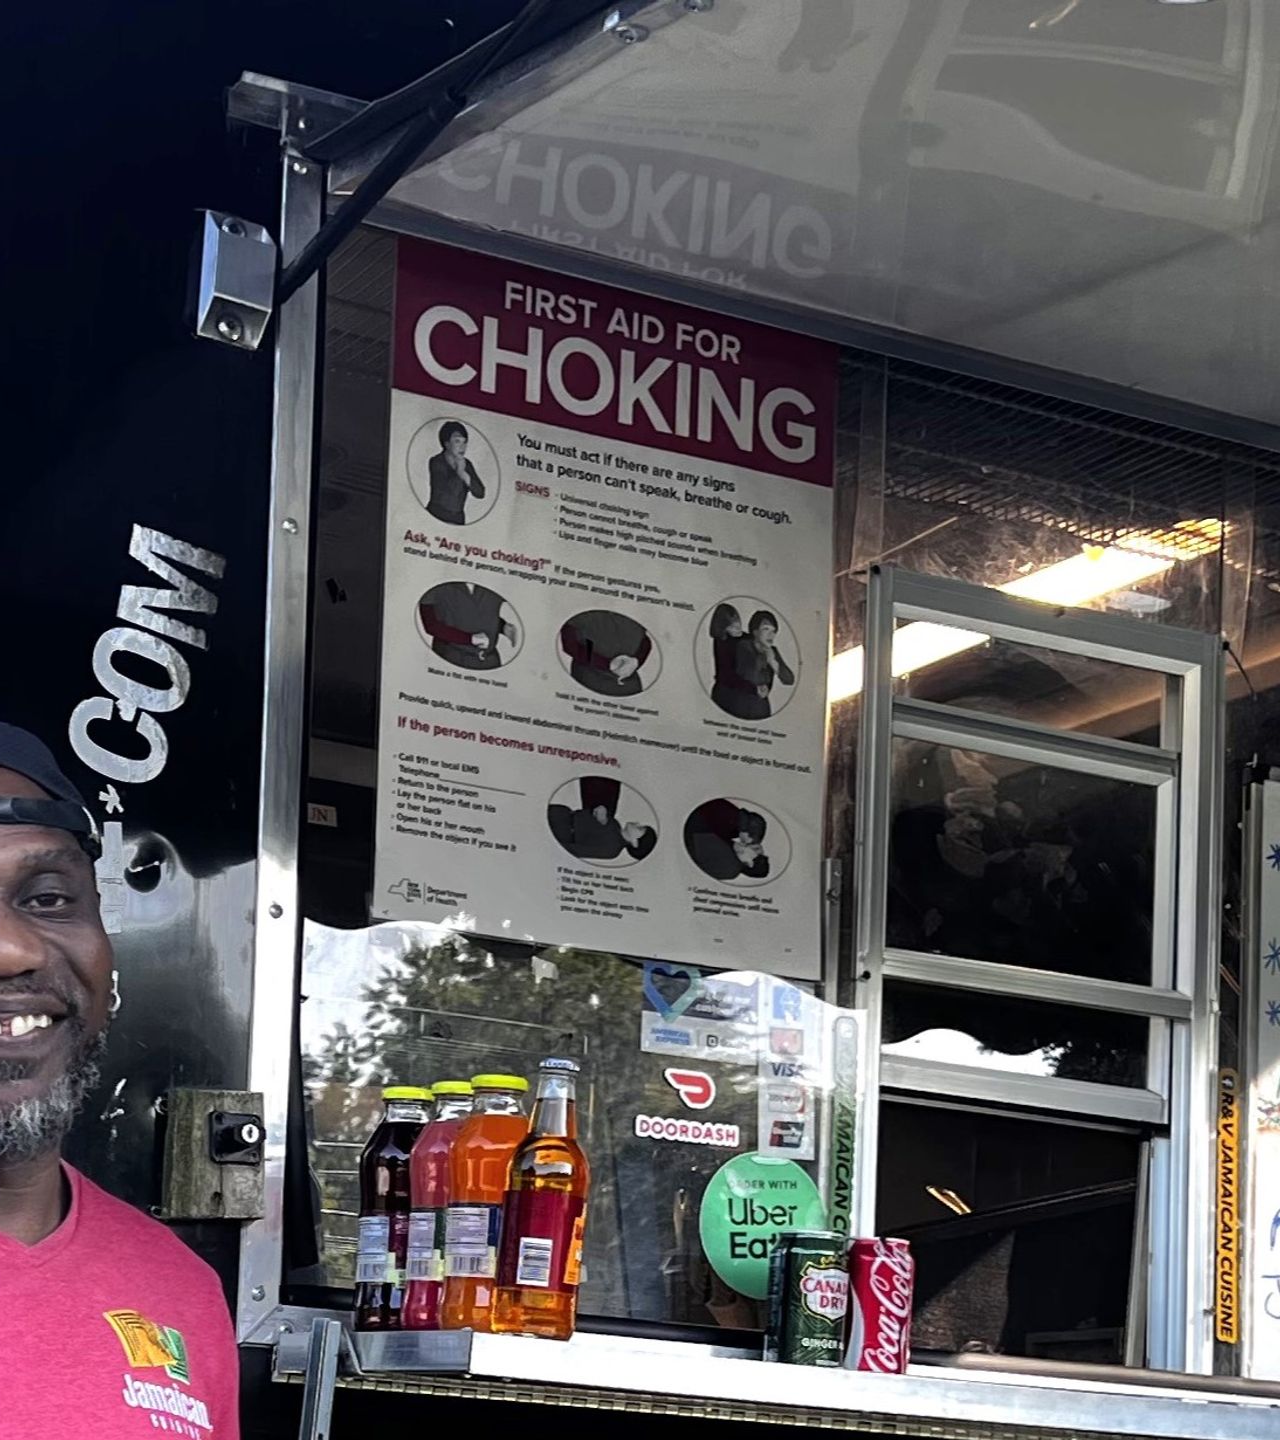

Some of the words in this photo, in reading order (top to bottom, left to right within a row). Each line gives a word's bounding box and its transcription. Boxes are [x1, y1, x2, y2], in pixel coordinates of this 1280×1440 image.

[504, 279, 598, 329] FIRST
[606, 307, 665, 346] AID
[674, 325, 742, 364] FOR
[413, 304, 817, 464] CHOKING
[516, 432, 542, 451] You
[544, 441, 578, 459] must
[580, 450, 601, 464] act
[603, 452, 613, 467] if
[615, 456, 650, 474] there
[652, 465, 674, 479] are
[676, 470, 700, 487] any
[702, 475, 736, 493] signs
[515, 480, 551, 498] SIGNS
[516, 453, 543, 471] that
[545, 462, 554, 474] a
[557, 465, 602, 484] person
[604, 475, 636, 492] can't
[639, 482, 681, 502] speak,
[684, 489, 733, 511] breathe
[736, 502, 750, 514] or
[752, 506, 793, 525] cough.
[403, 529, 431, 547] Ask,
[434, 535, 462, 553] "Are
[464, 544, 488, 558] you
[397, 715, 408, 728] If
[409, 718, 431, 734] the
[432, 724, 477, 743] person
[479, 730, 535, 752] becomes
[639, 1119, 738, 1143] DOORDASH
[832, 1091, 854, 1212] AMAICAN
[768, 1180, 798, 1190] WITH
[1219, 1142, 1234, 1253] JAMAICAN
[727, 1198, 799, 1226] Uber
[729, 1231, 778, 1260] Eat
[1218, 1255, 1233, 1338] CUISINE
